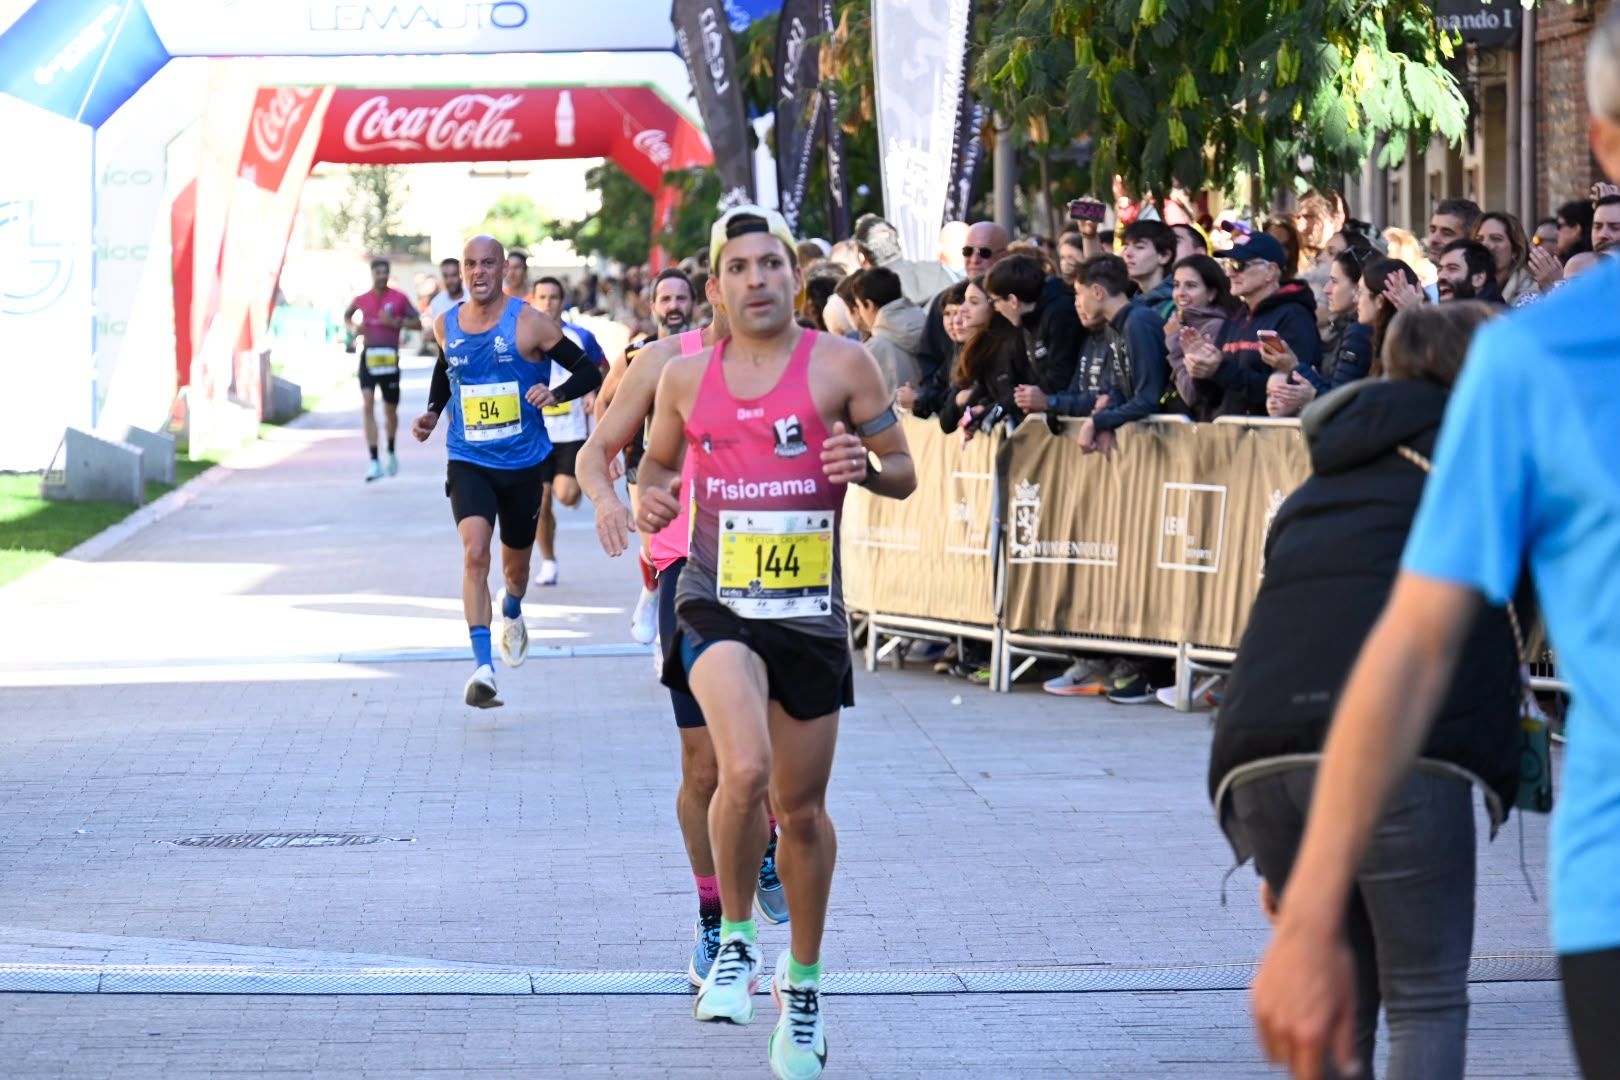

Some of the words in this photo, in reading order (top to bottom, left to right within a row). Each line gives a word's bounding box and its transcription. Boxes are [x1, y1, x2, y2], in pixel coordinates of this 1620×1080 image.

[1435, 9, 1500, 29] nando
[343, 93, 525, 151] Coca-Cola
[480, 401, 500, 419] 94
[706, 476, 816, 500] Fisiorama
[756, 544, 800, 578] 144
